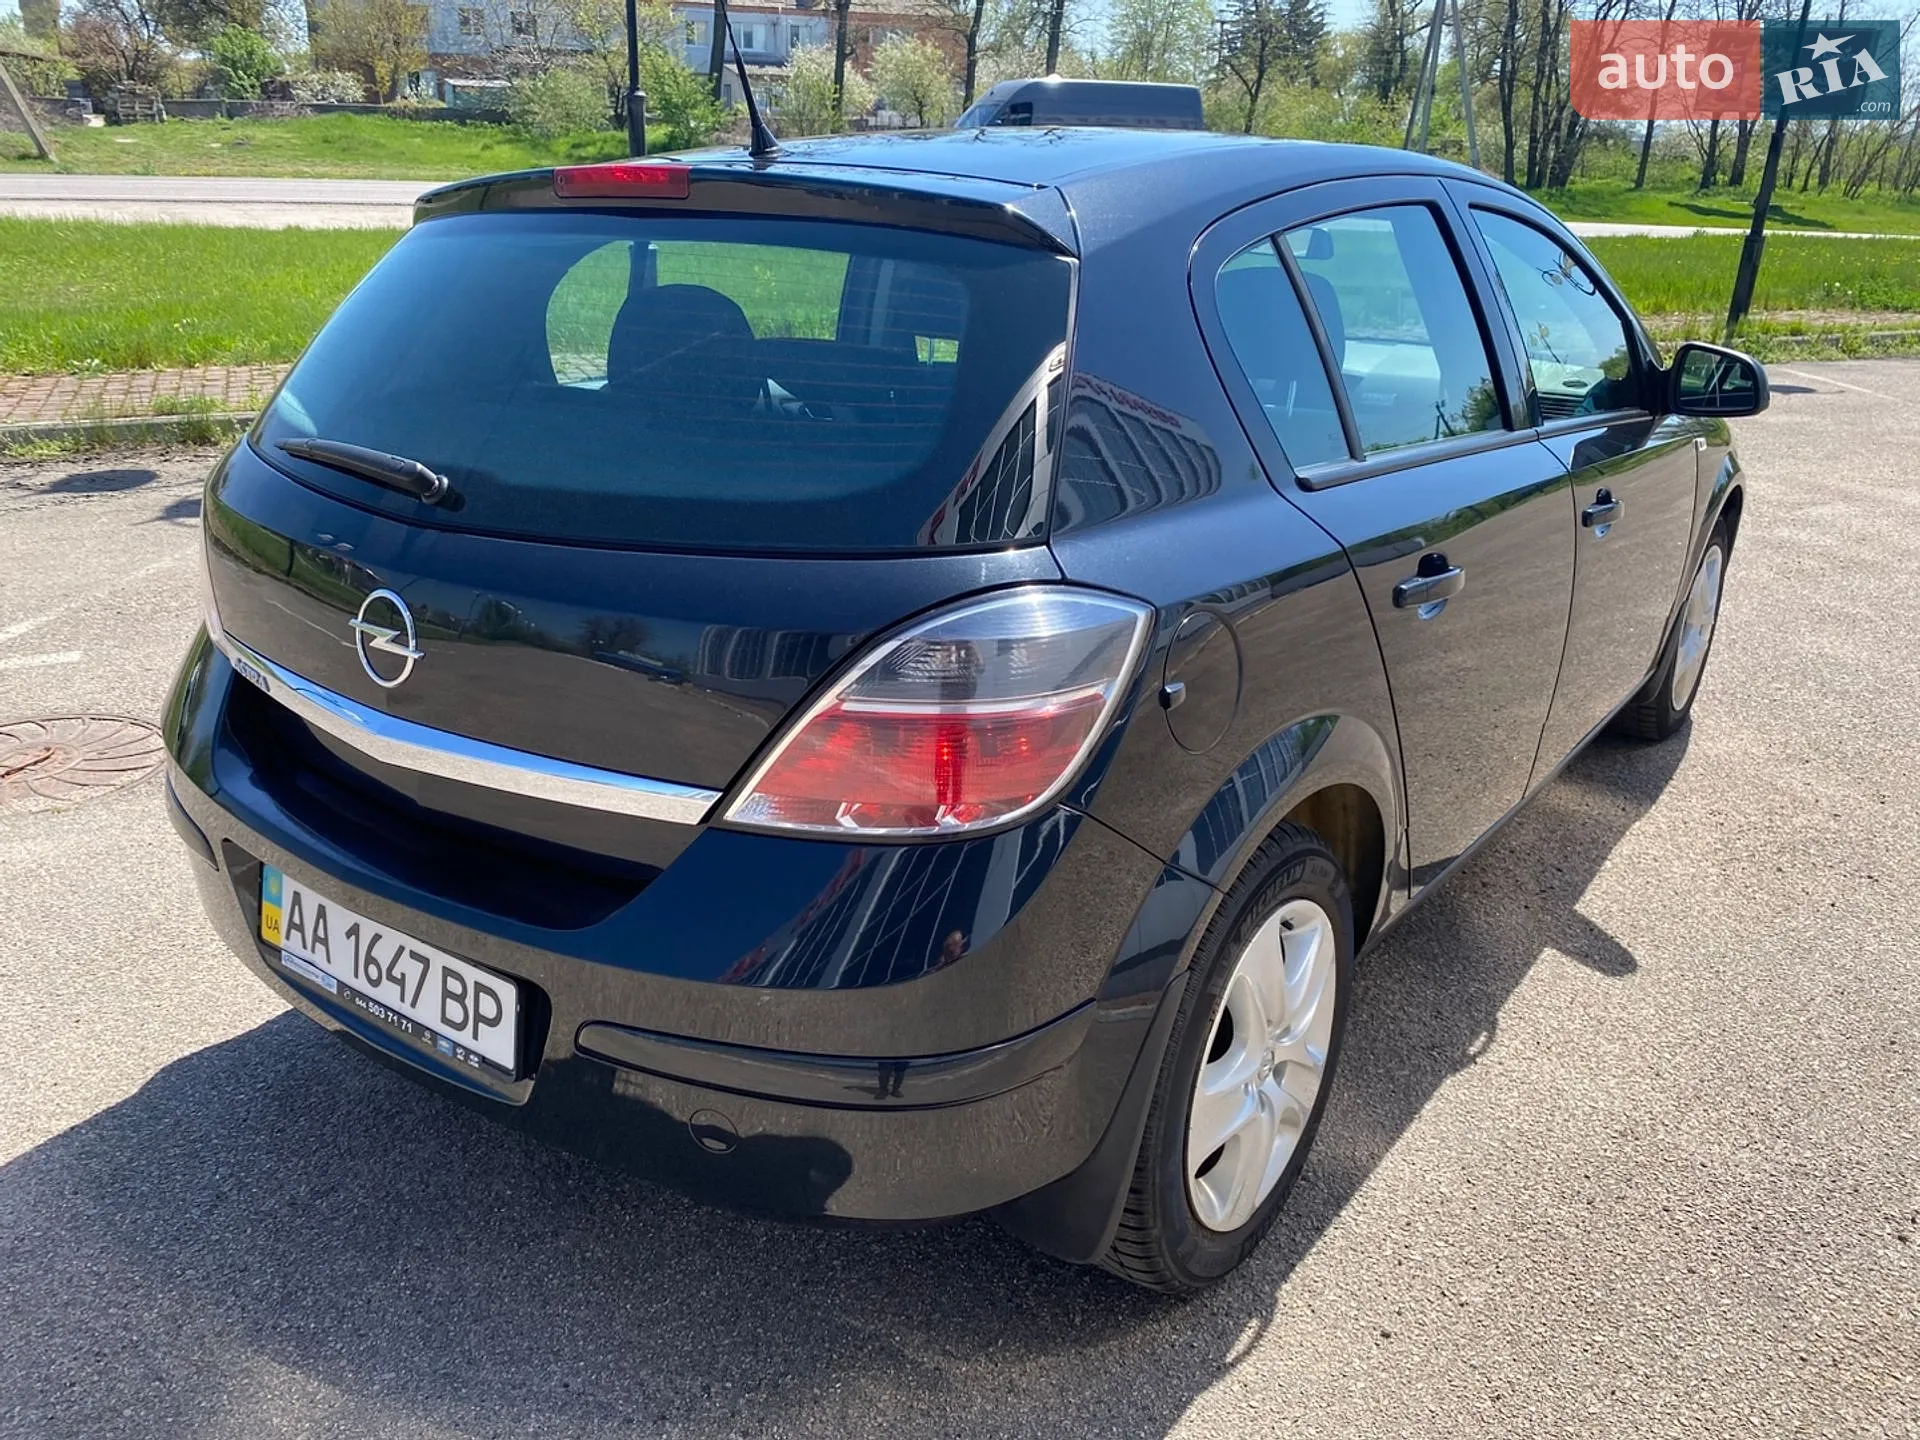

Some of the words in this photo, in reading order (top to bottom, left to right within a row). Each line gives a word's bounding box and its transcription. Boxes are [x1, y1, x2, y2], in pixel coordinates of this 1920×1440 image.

[265, 915, 281, 935] UA
[285, 890, 331, 964] AA
[345, 922, 431, 1009] 1647
[441, 966, 503, 1041] BP
[368, 1002, 386, 1019] 503
[387, 1012, 398, 1027] 71
[402, 1019, 413, 1033] 71
